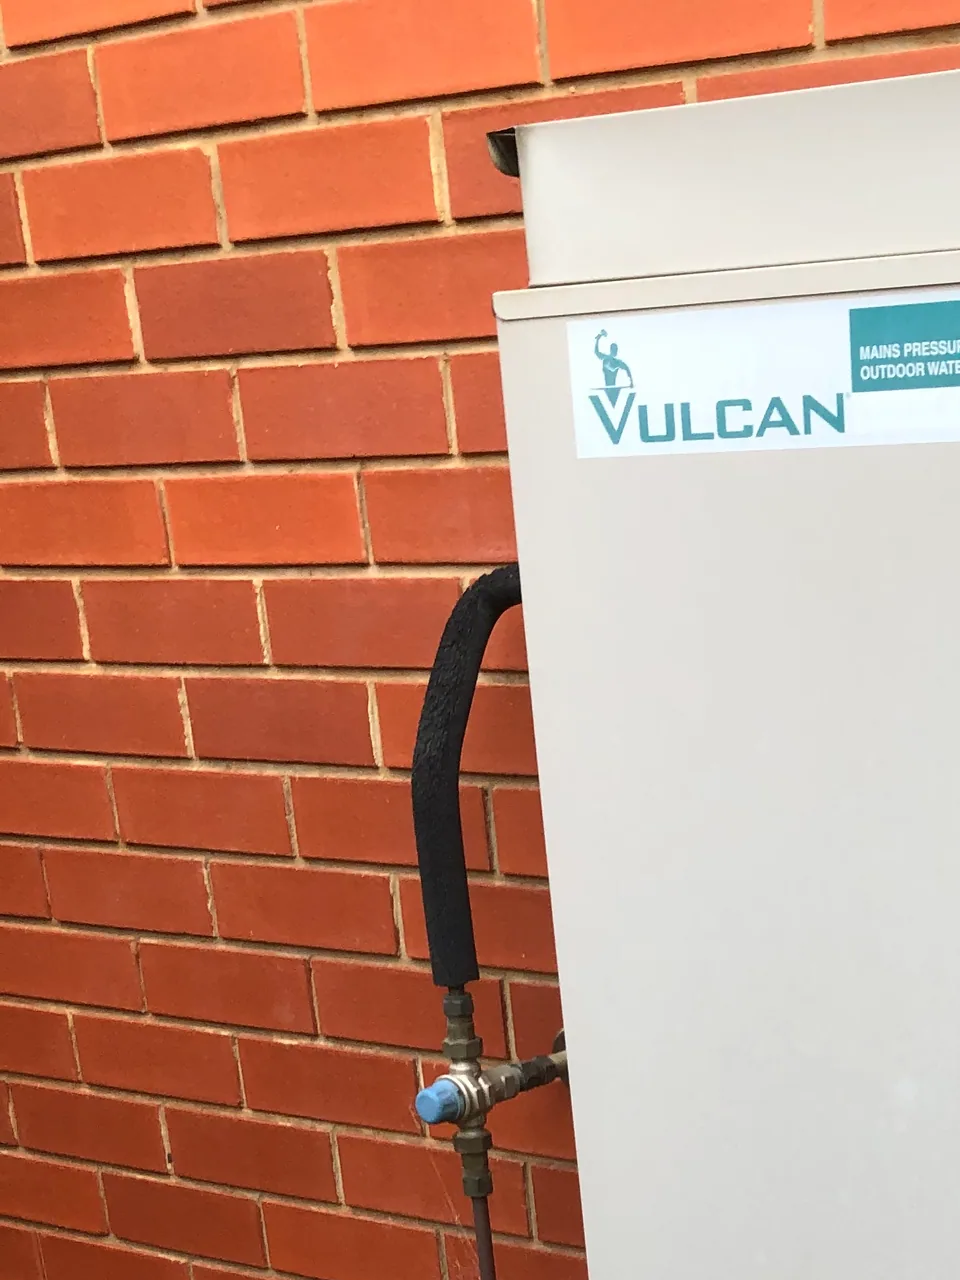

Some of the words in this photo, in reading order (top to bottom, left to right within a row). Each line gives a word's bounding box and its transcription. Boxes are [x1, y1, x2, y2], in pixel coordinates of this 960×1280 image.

[859, 343, 900, 360] MAINS
[860, 362, 925, 381] OUTDOOR
[588, 392, 845, 445] VULCAN
